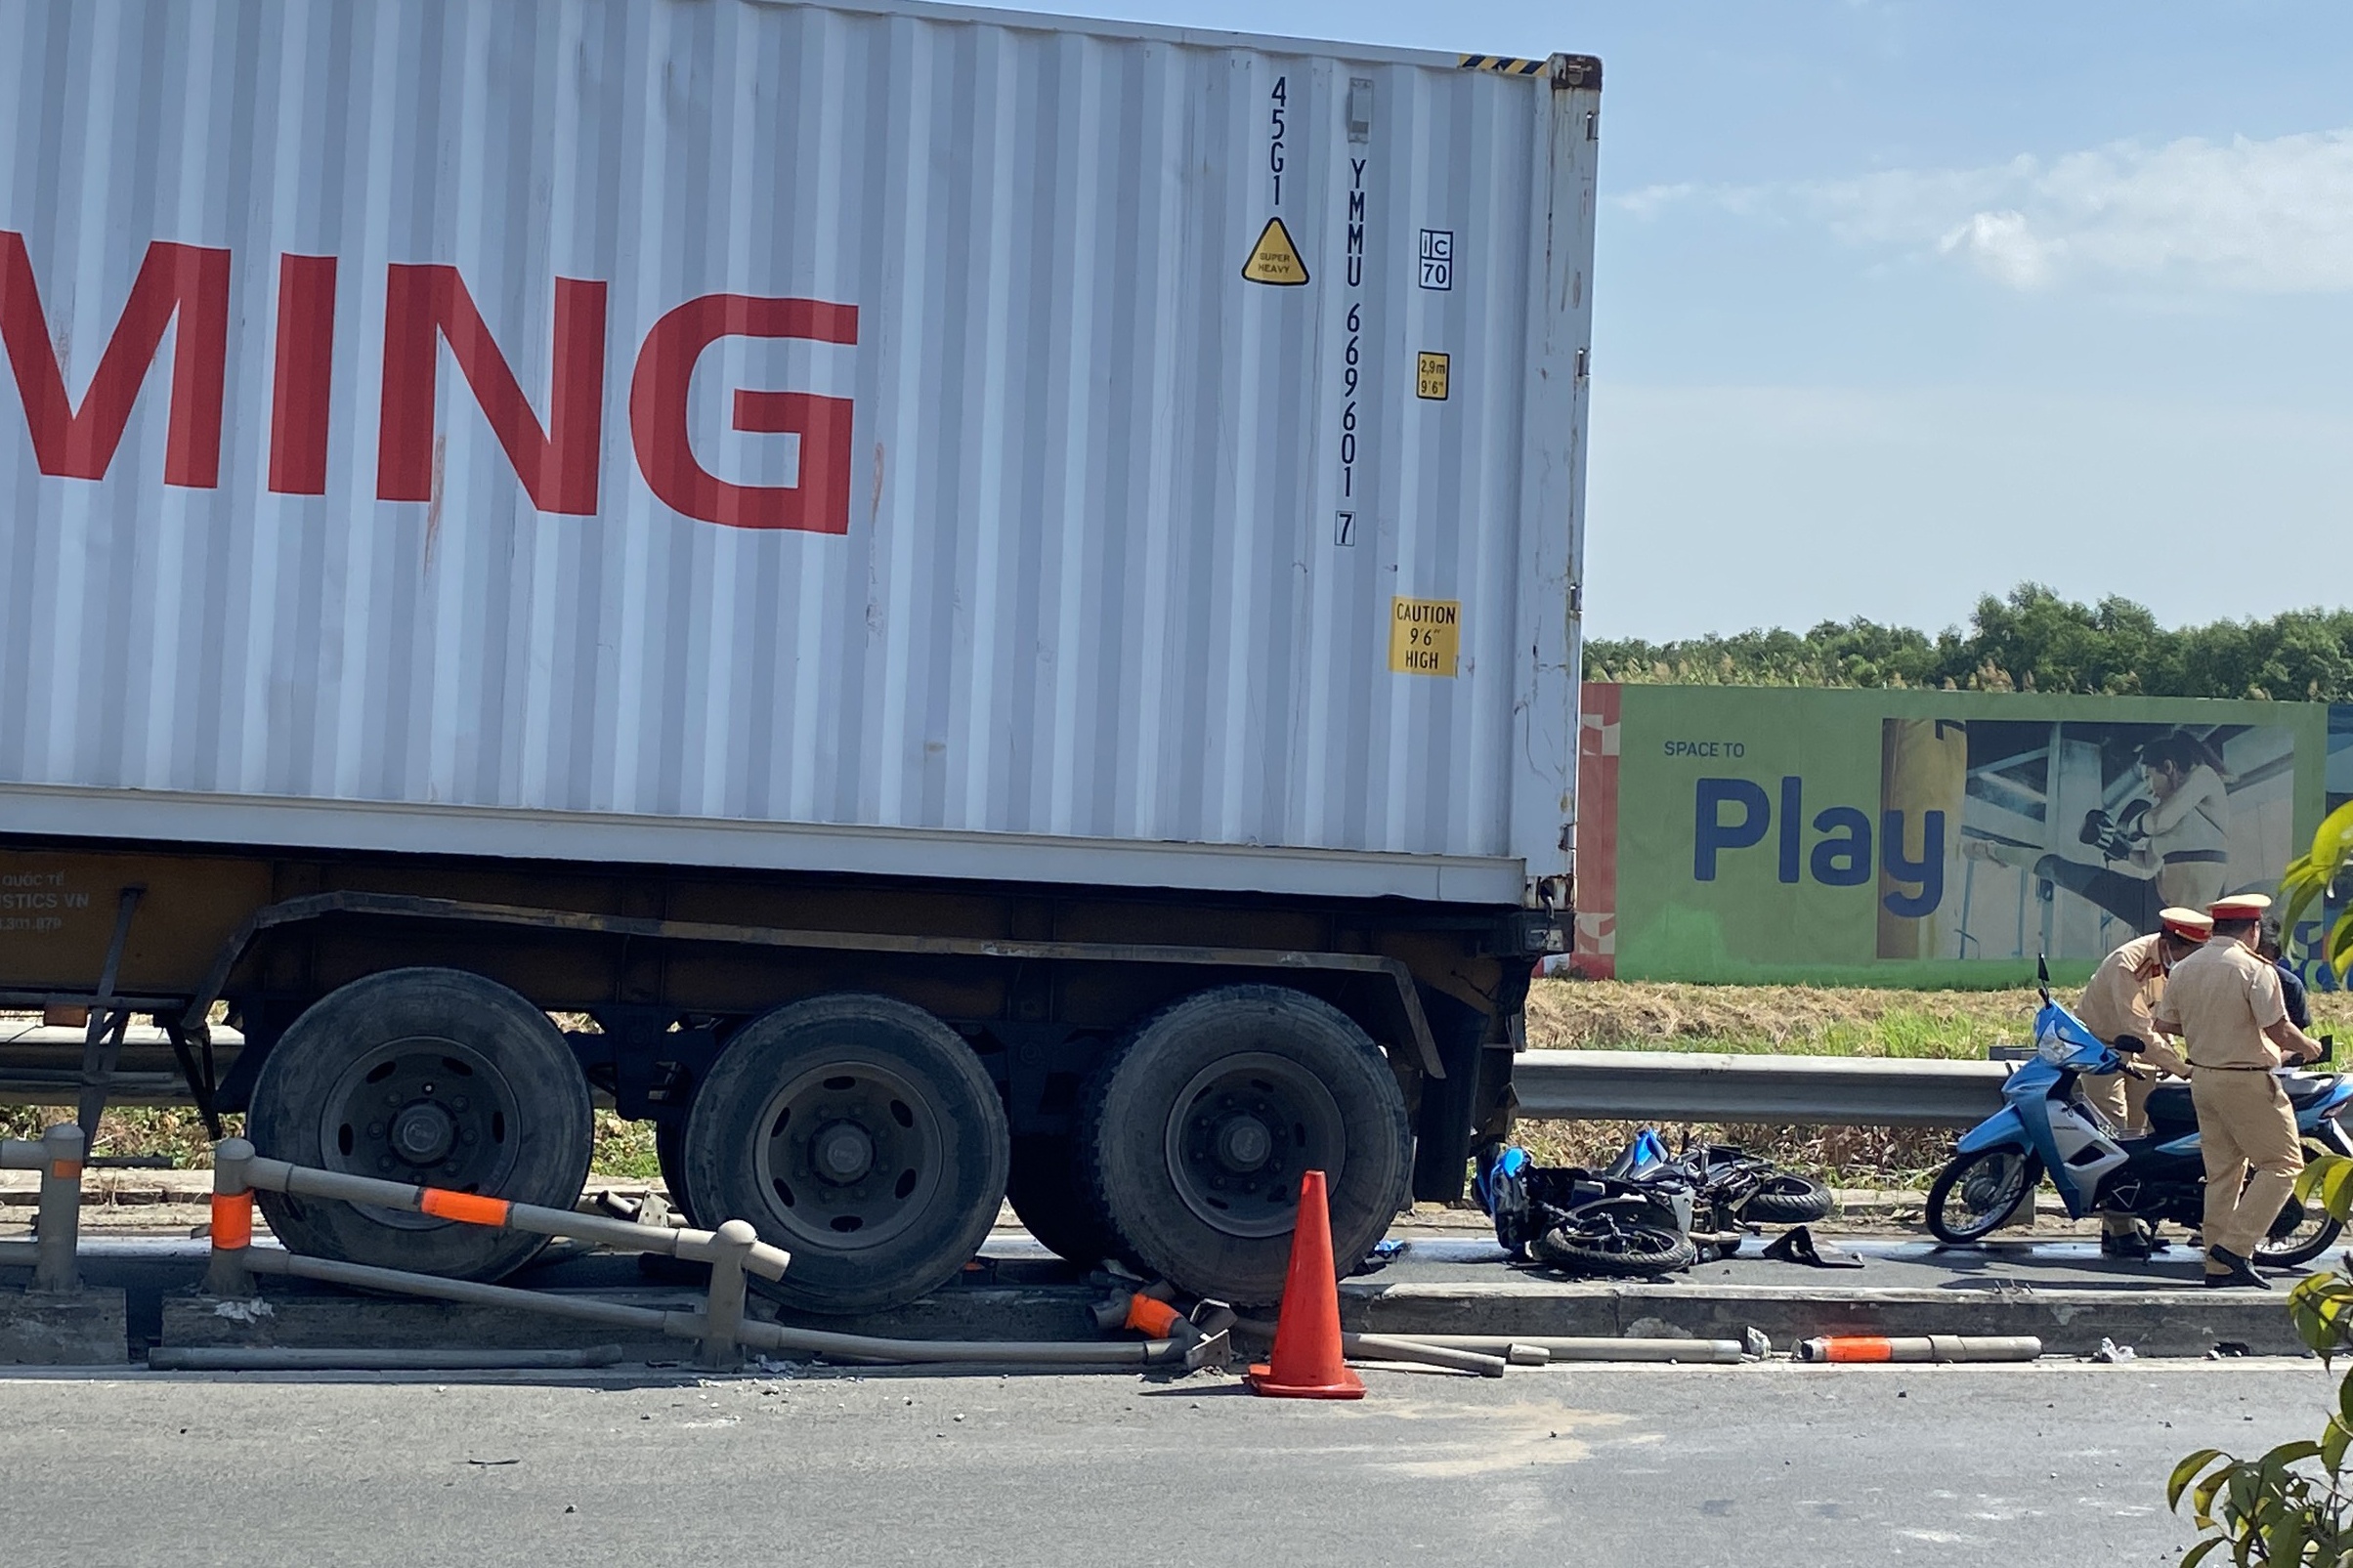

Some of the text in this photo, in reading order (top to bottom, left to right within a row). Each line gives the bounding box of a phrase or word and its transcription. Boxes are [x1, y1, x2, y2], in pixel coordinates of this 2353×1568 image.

[1270, 76, 1287, 206] 45G1
[1260, 252, 1290, 263] SUPER
[1258, 263, 1290, 275] HEAVY
[1423, 263, 1447, 284] 70
[1339, 157, 1367, 544] YMMU 669601 7
[0, 230, 859, 535] MING
[1396, 602, 1456, 625] CAUTION
[1405, 650, 1438, 669] HIGH
[1663, 741, 1745, 758] SPACE TO
[1693, 776, 1946, 918] Play
[64, 892, 90, 909] VN
